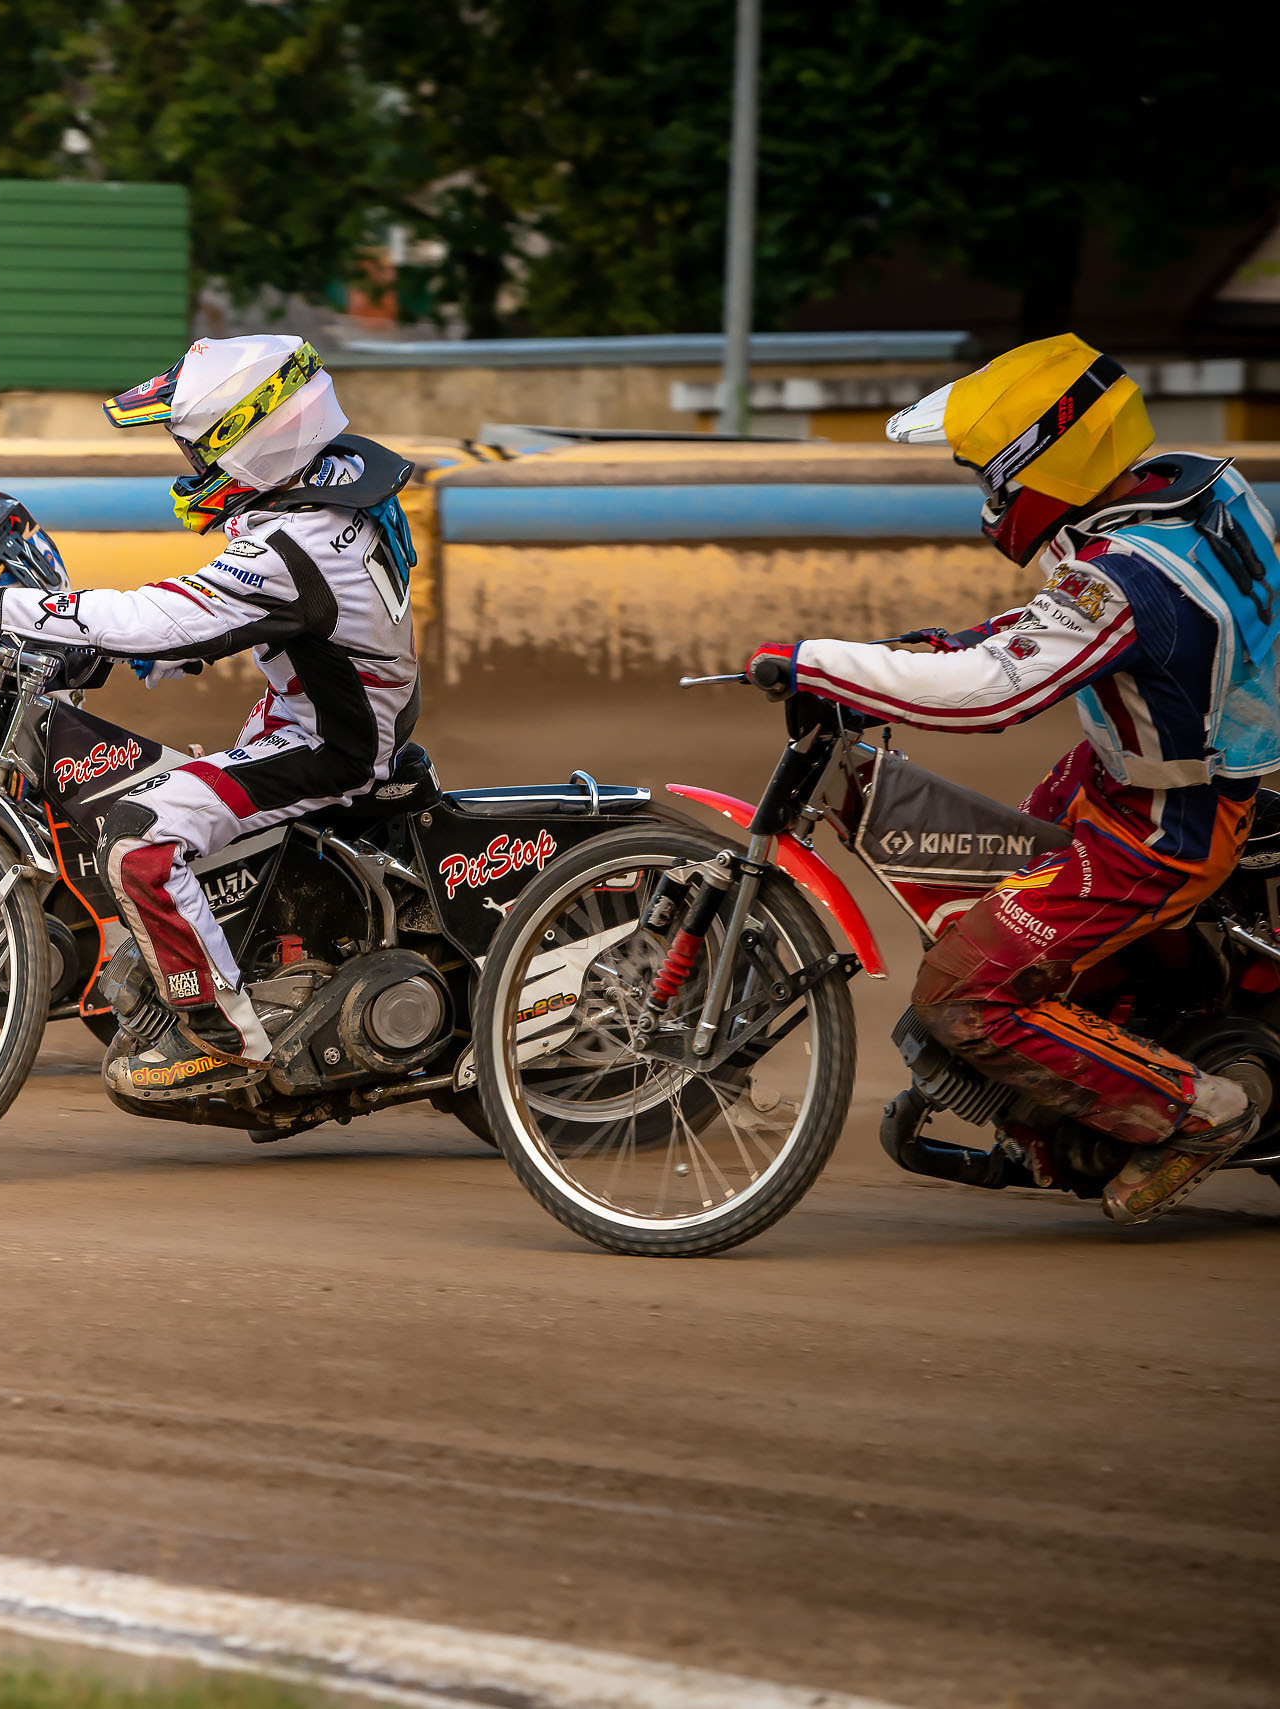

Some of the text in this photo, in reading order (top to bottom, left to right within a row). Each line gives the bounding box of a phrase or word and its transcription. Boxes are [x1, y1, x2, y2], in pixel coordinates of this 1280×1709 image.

[329, 509, 370, 554] KOST
[56, 595, 70, 613] MTC
[1031, 599, 1051, 612] AS
[53, 738, 142, 793] PitStop
[920, 832, 1036, 856] KING TONY
[439, 829, 557, 899] PitStop
[994, 911, 1048, 947] ANNO 1989
[999, 888, 1057, 940] AUSEKLIS
[515, 992, 577, 1023] an2Go
[131, 1055, 230, 1087] daytona
